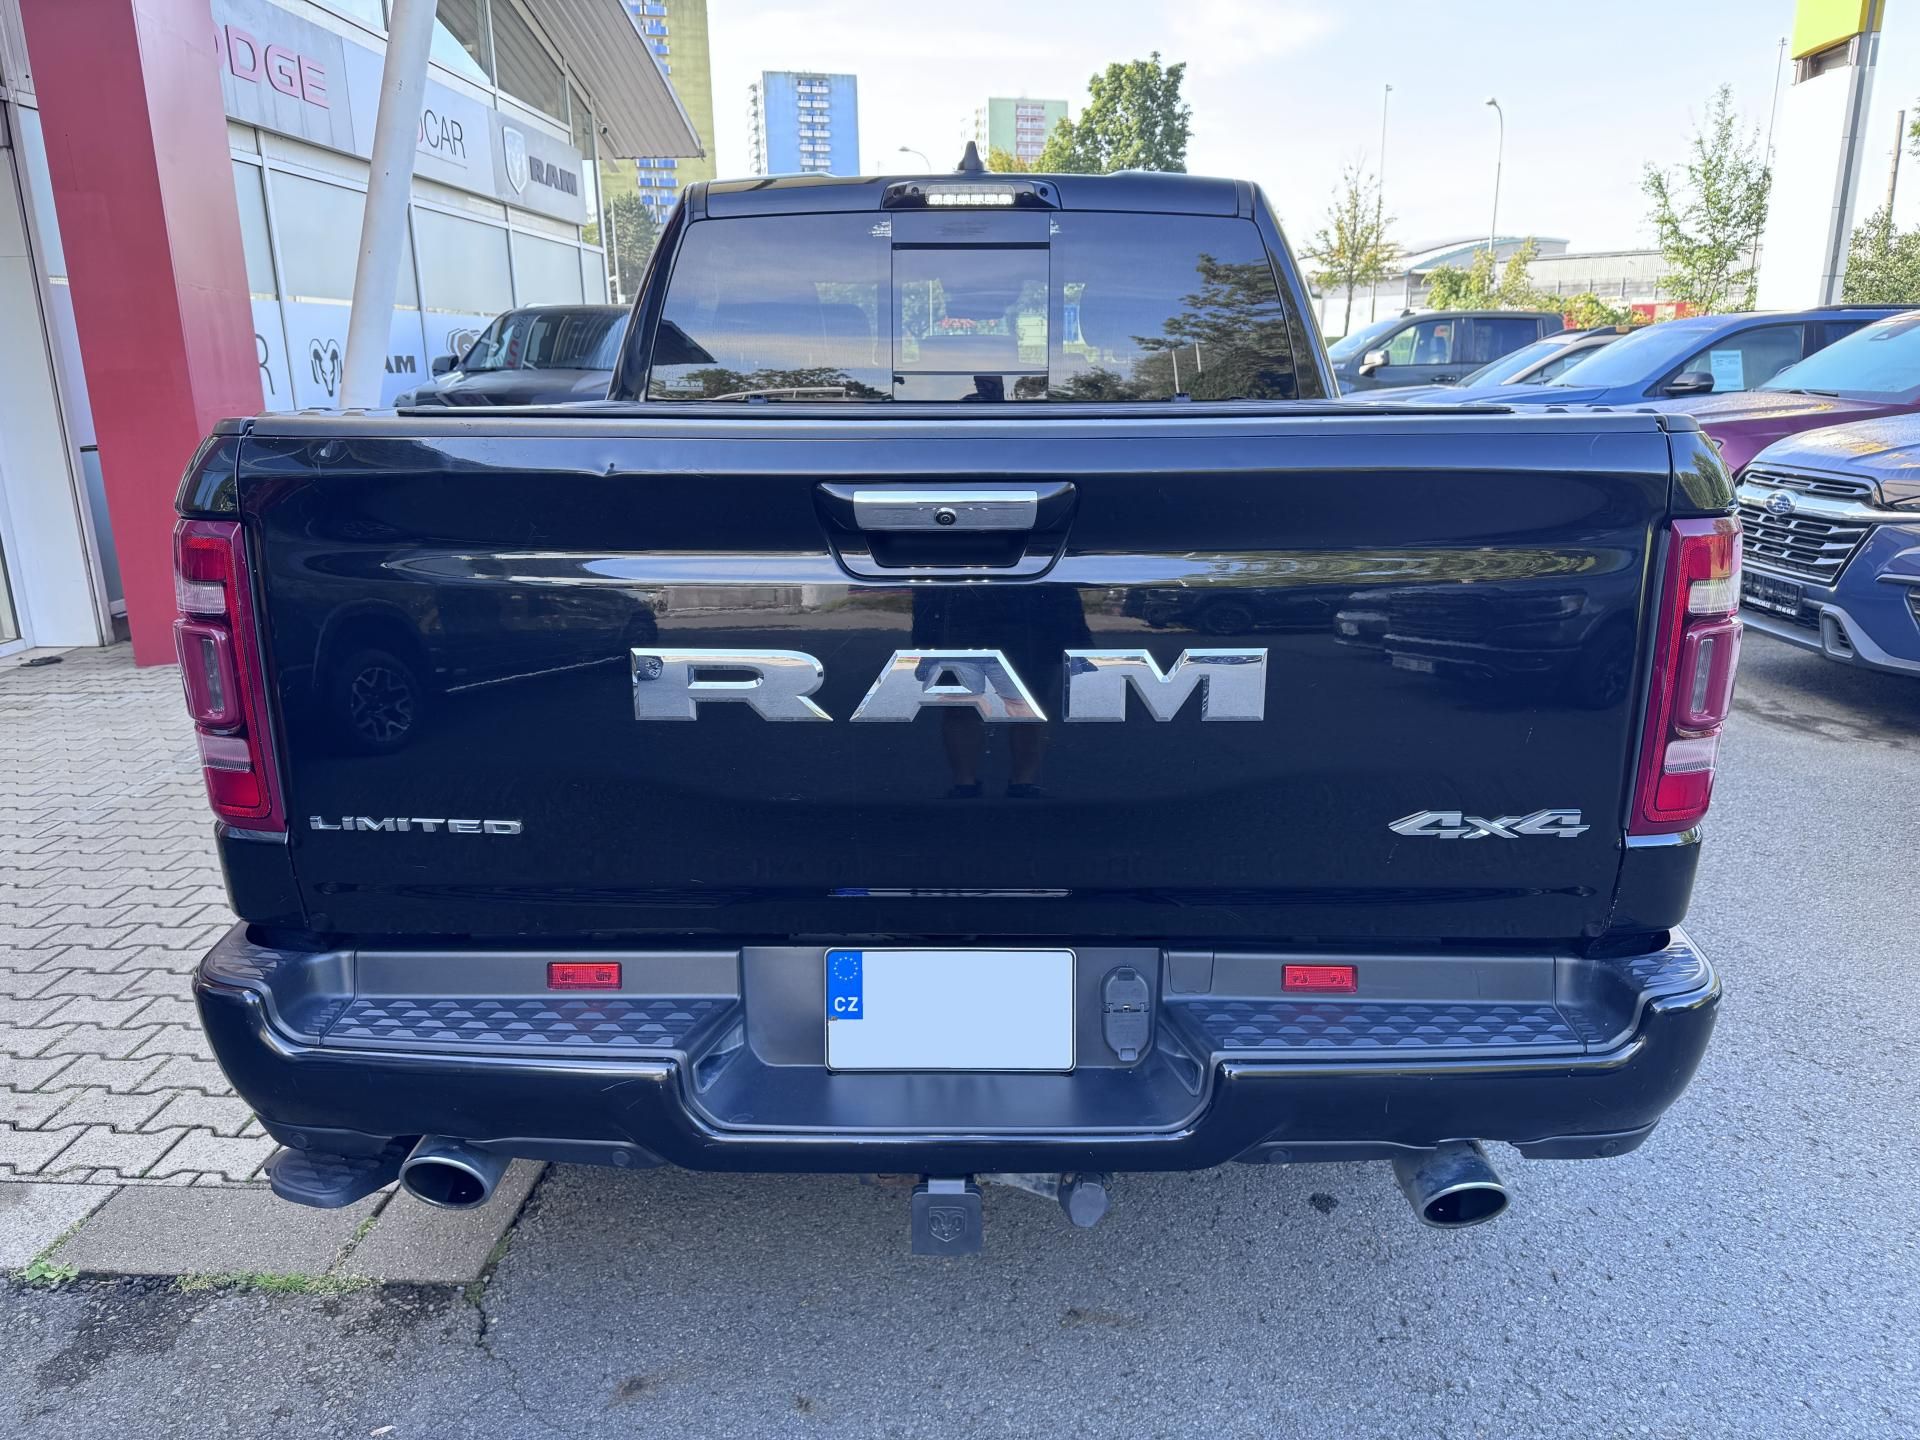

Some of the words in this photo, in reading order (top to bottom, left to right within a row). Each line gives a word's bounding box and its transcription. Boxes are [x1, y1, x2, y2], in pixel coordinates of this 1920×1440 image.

[417, 109, 467, 159] CAR
[529, 155, 578, 197] RAM
[631, 647, 1268, 722] RAM
[309, 815, 524, 834] LIMITED
[1388, 808, 1590, 839] 4x4
[834, 996, 859, 1013] CZ
